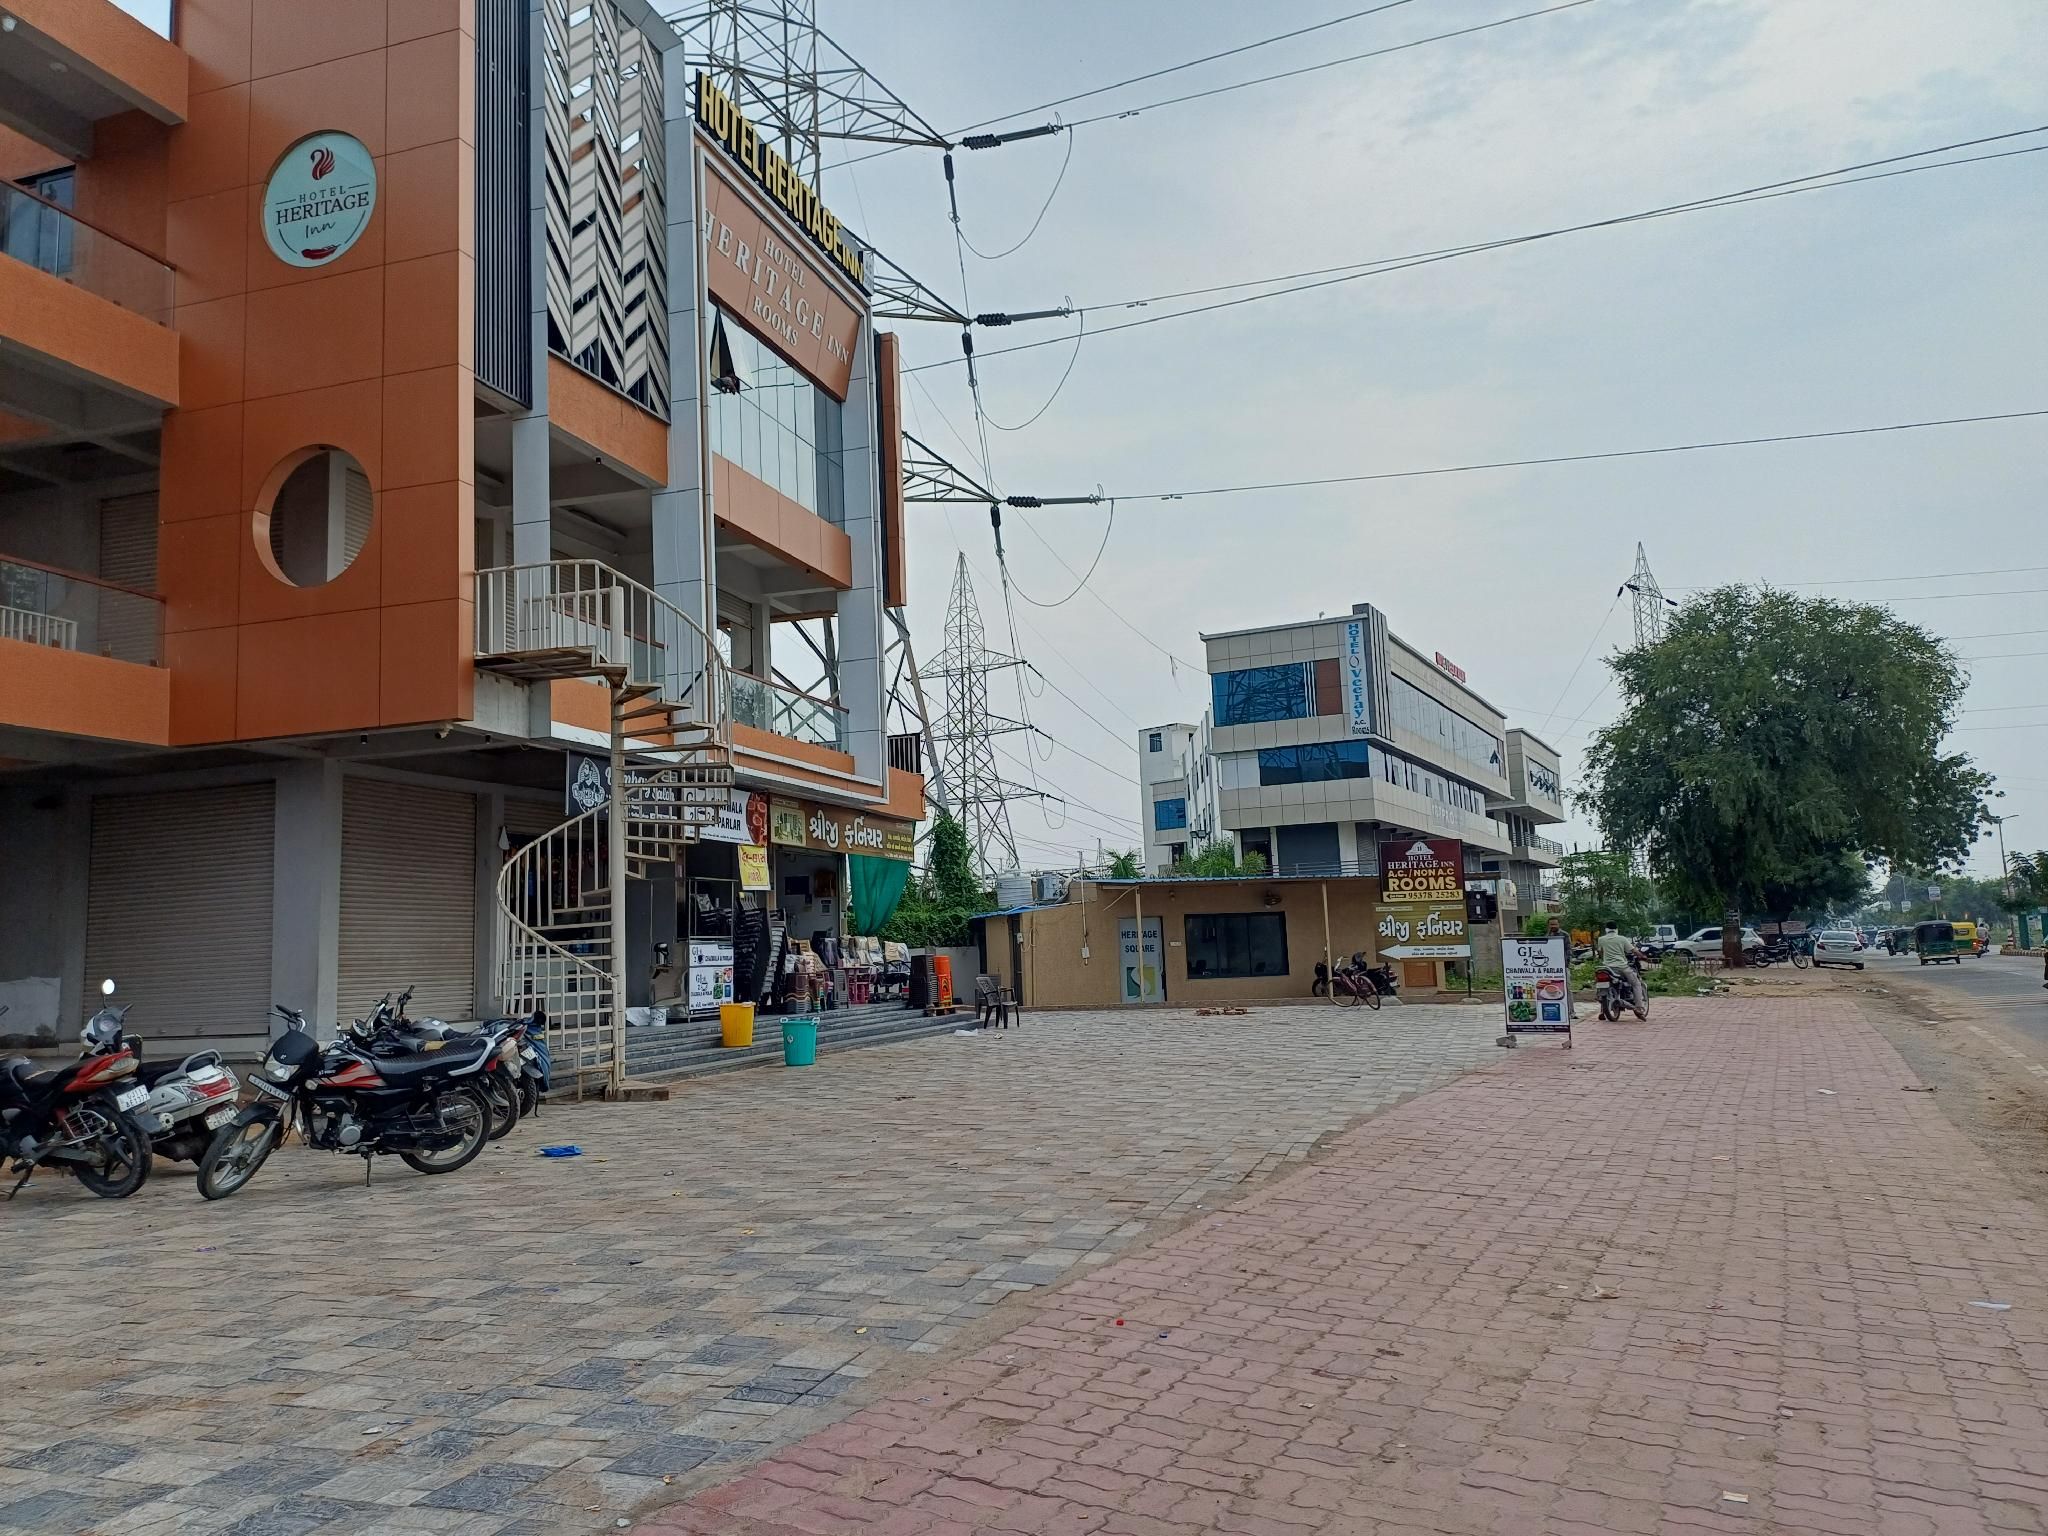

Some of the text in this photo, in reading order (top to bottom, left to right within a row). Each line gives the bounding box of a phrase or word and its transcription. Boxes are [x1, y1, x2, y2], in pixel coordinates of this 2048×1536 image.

[701, 72, 864, 284] HOTEL HERITAGE INN
[299, 185, 346, 204] HOTEL
[275, 191, 369, 225] HERITAGE
[305, 221, 336, 239] Inn
[764, 236, 806, 289] HOTEL
[753, 296, 799, 346] ROOMS
[827, 335, 850, 366] INN
[1348, 624, 1360, 654] HOTEL
[1387, 860, 1440, 870] HERITAGE
[1414, 869, 1436, 877] NON
[1388, 876, 1457, 891] ROOMS
[1436, 891, 1460, 899] 25283
[1121, 930, 1158, 939] HERIAGE
[1523, 958, 1529, 966] 2
